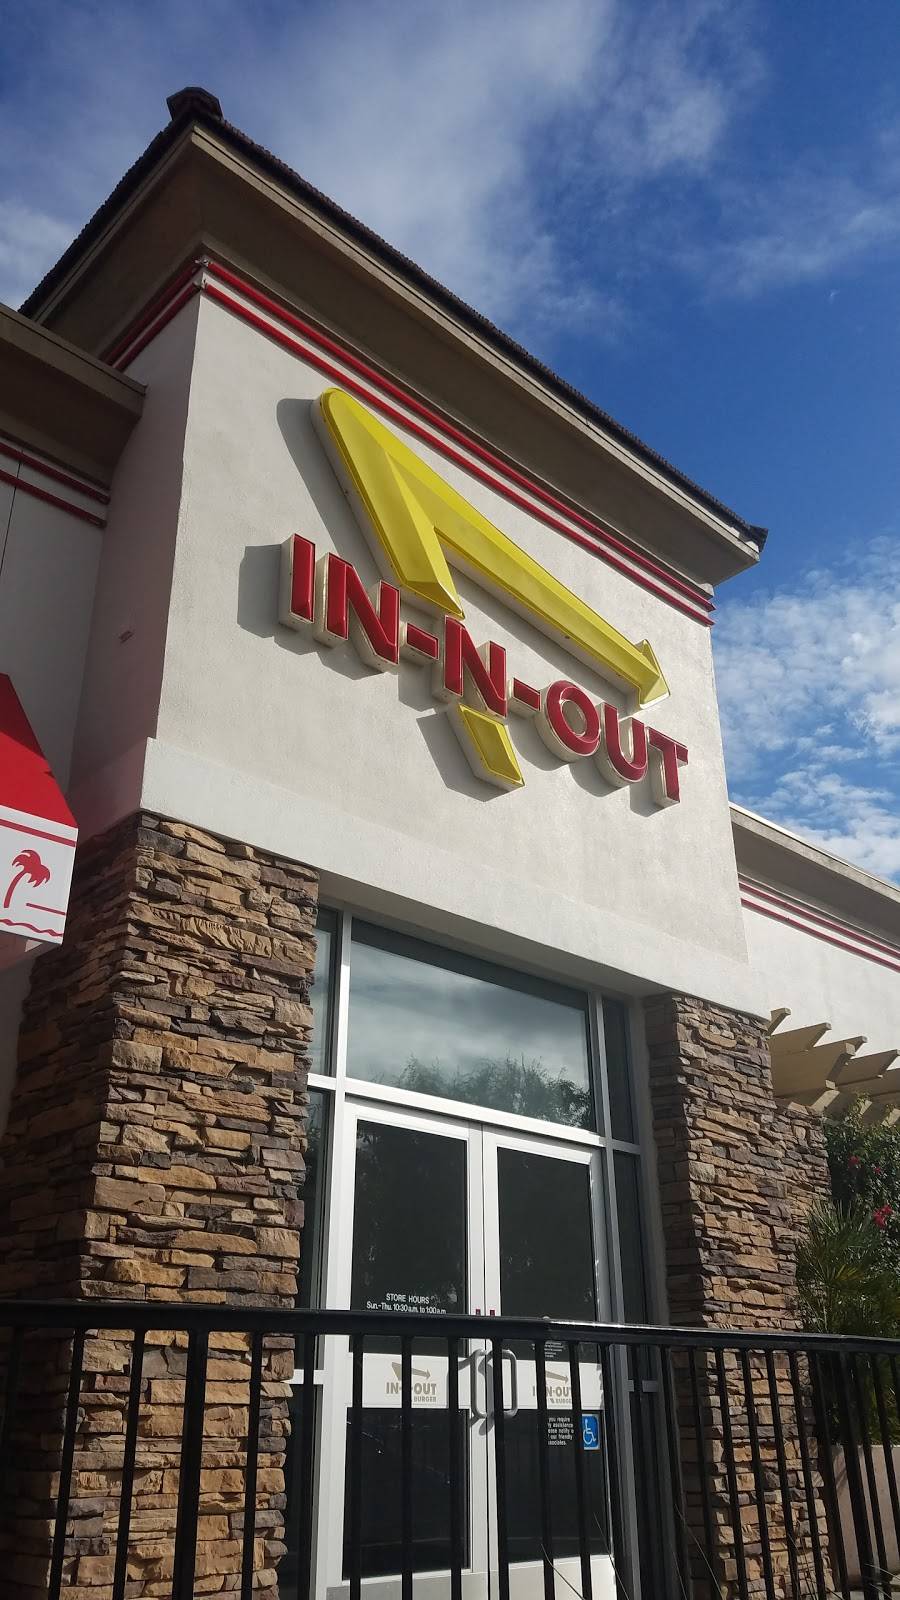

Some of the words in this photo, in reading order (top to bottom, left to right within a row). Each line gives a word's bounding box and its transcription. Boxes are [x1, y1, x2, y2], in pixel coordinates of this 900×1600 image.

[282, 532, 689, 806] IN-N-OUT
[386, 1292, 406, 1302] STORE
[408, 1295, 429, 1304] HOURS
[393, 1304, 408, 1312] 10:30
